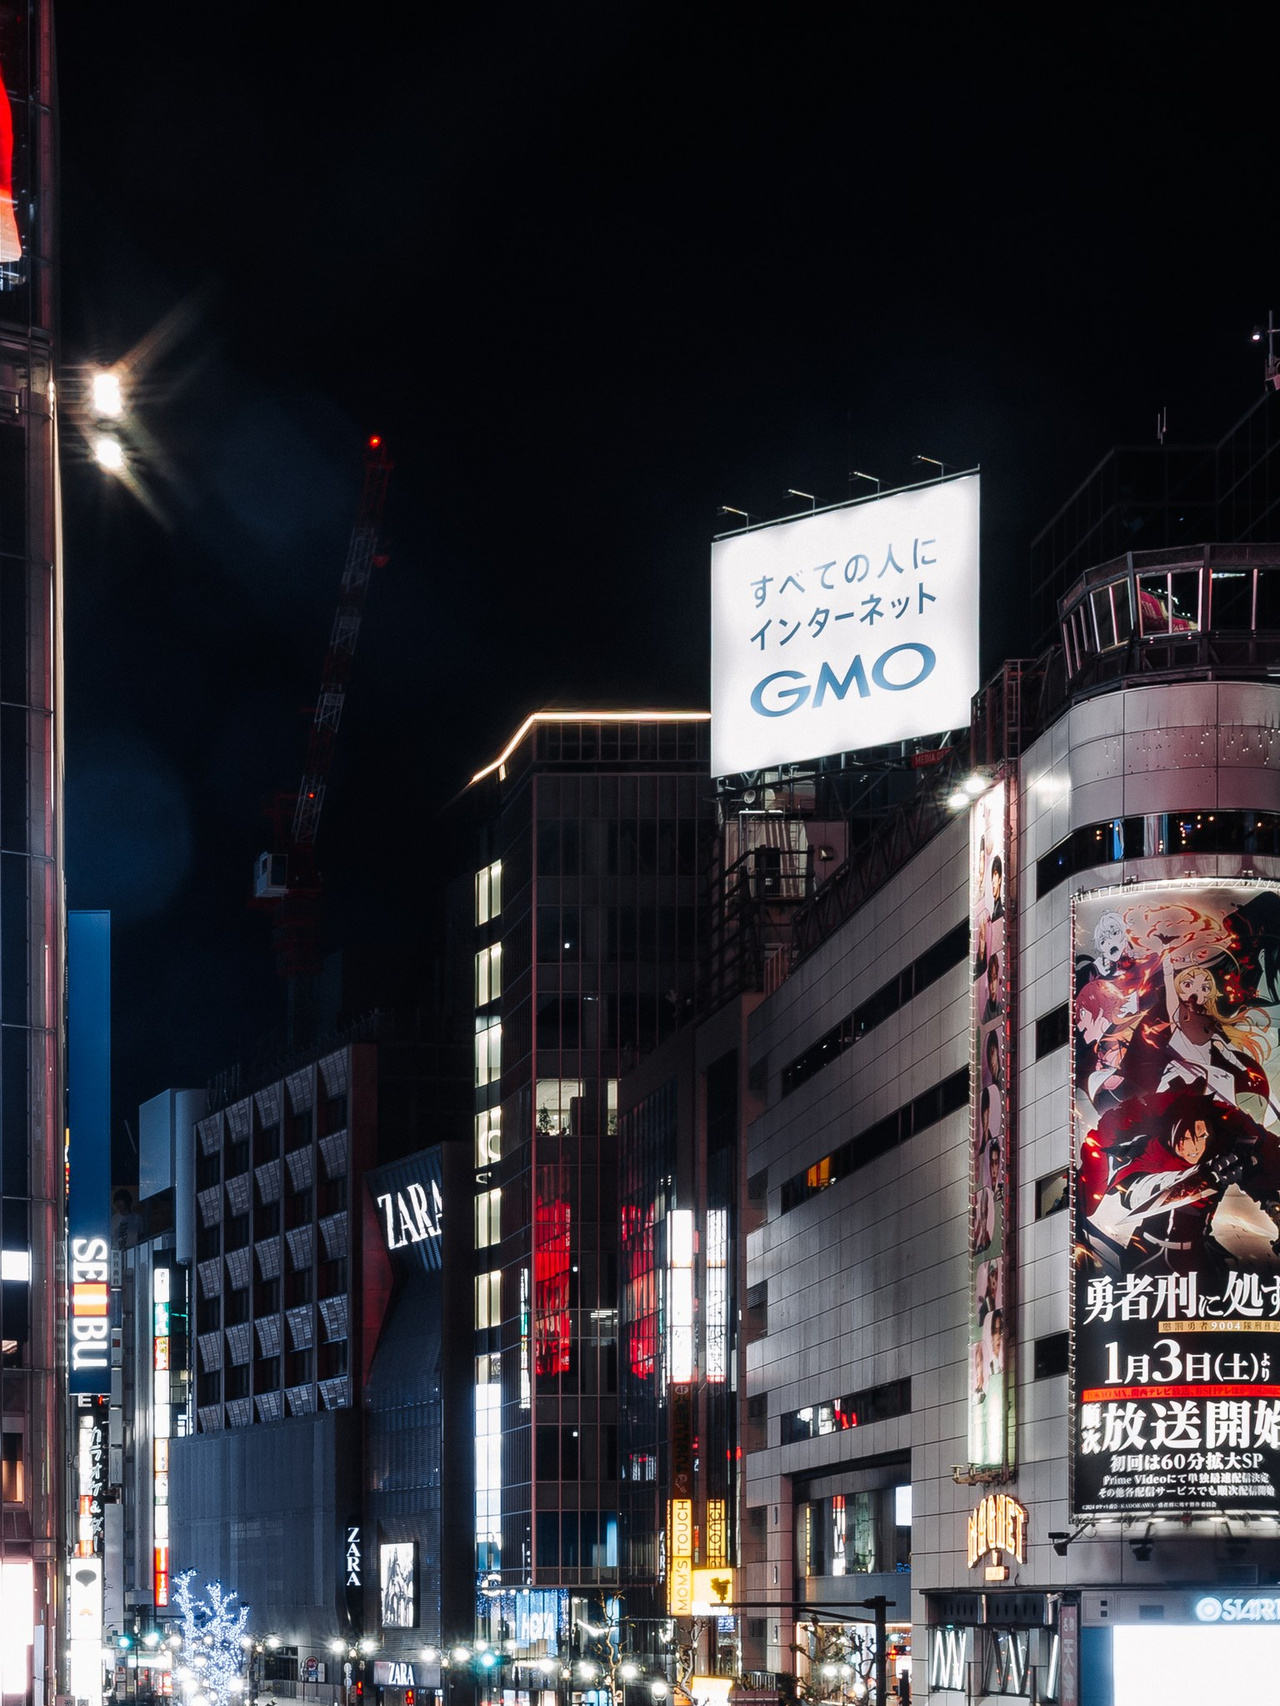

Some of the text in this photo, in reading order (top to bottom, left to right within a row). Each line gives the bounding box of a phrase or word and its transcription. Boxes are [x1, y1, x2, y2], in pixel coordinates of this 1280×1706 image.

[750, 538, 937, 609] すべての人に
[750, 582, 937, 651] インターネット
[750, 642, 937, 718] GMO
[377, 1179, 443, 1250] ZARA
[1102, 1475, 1133, 1486] Prime
[346, 1527, 361, 1587] ZARA
[676, 1500, 690, 1611] MOM'S TOUCH
[967, 1493, 1027, 1570] MAGNET
[387, 1662, 415, 1686] ZARA
